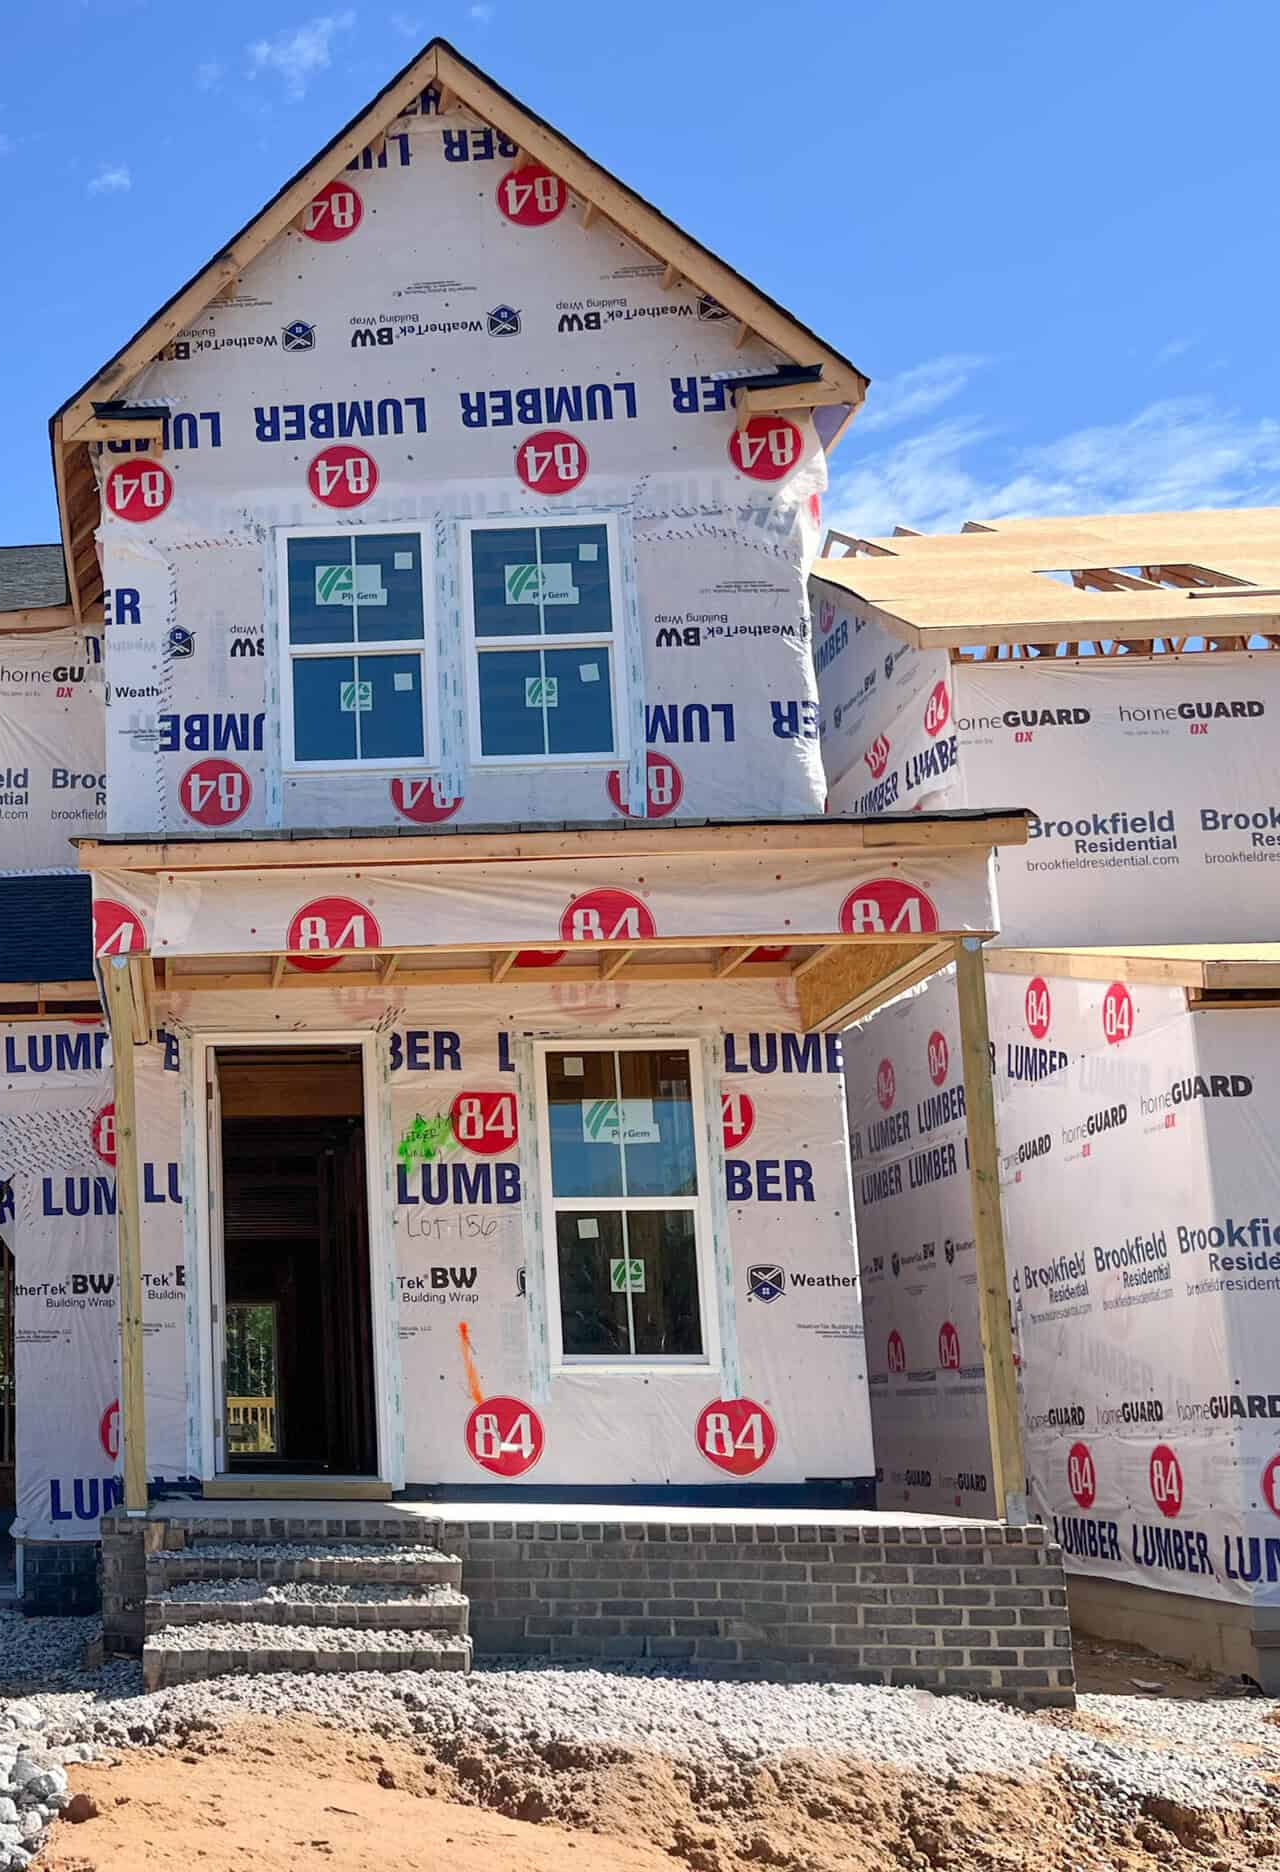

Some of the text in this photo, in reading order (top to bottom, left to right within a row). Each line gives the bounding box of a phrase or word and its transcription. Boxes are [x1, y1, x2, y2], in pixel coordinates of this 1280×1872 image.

[504, 177, 560, 216] 84
[350, 313, 419, 326] Building Wrap
[556, 298, 628, 311] Building Wrap
[558, 304, 693, 333] WeatherTek BW
[351, 319, 483, 348] WeatherTek BW
[254, 396, 428, 442] LUMBER
[461, 382, 638, 428] LUMBER
[523, 442, 580, 483] 84
[737, 426, 794, 469] 84
[111, 470, 165, 511] 84
[314, 457, 370, 496] 84
[356, 590, 378, 600] Gem
[548, 590, 569, 599] Gem
[654, 613, 728, 625] Building Wrap
[655, 627, 701, 648] BW
[1119, 700, 1266, 723] homeGUARD
[1014, 723, 1209, 743] OX OX
[187, 772, 243, 812] 84
[1026, 853, 1180, 872] brookfieldresidential.com
[1075, 835, 1178, 854] Residential
[298, 914, 366, 951] 84
[571, 906, 642, 940] 84
[850, 897, 921, 933] 84
[1028, 989, 1049, 1027] 84
[1105, 995, 1131, 1038] 84
[917, 1083, 967, 1134] LUMBER
[1140, 1074, 1254, 1117] homeGUARD
[458, 1096, 515, 1140] 84
[628, 1127, 651, 1138] Gem
[908, 1142, 958, 1189] LUMBER
[407, 1209, 497, 1241] LOT 156
[1093, 1229, 1168, 1273] Brookfield
[71, 1273, 114, 1295] BW
[430, 1266, 478, 1289] BW
[45, 1297, 86, 1310] Building
[402, 1292, 479, 1304] Building Wrap
[474, 1412, 536, 1459] 84
[705, 1412, 767, 1460] 84
[1070, 1456, 1093, 1496] 84
[1151, 1459, 1180, 1503] 84
[1132, 1523, 1215, 1576] LUMBER
